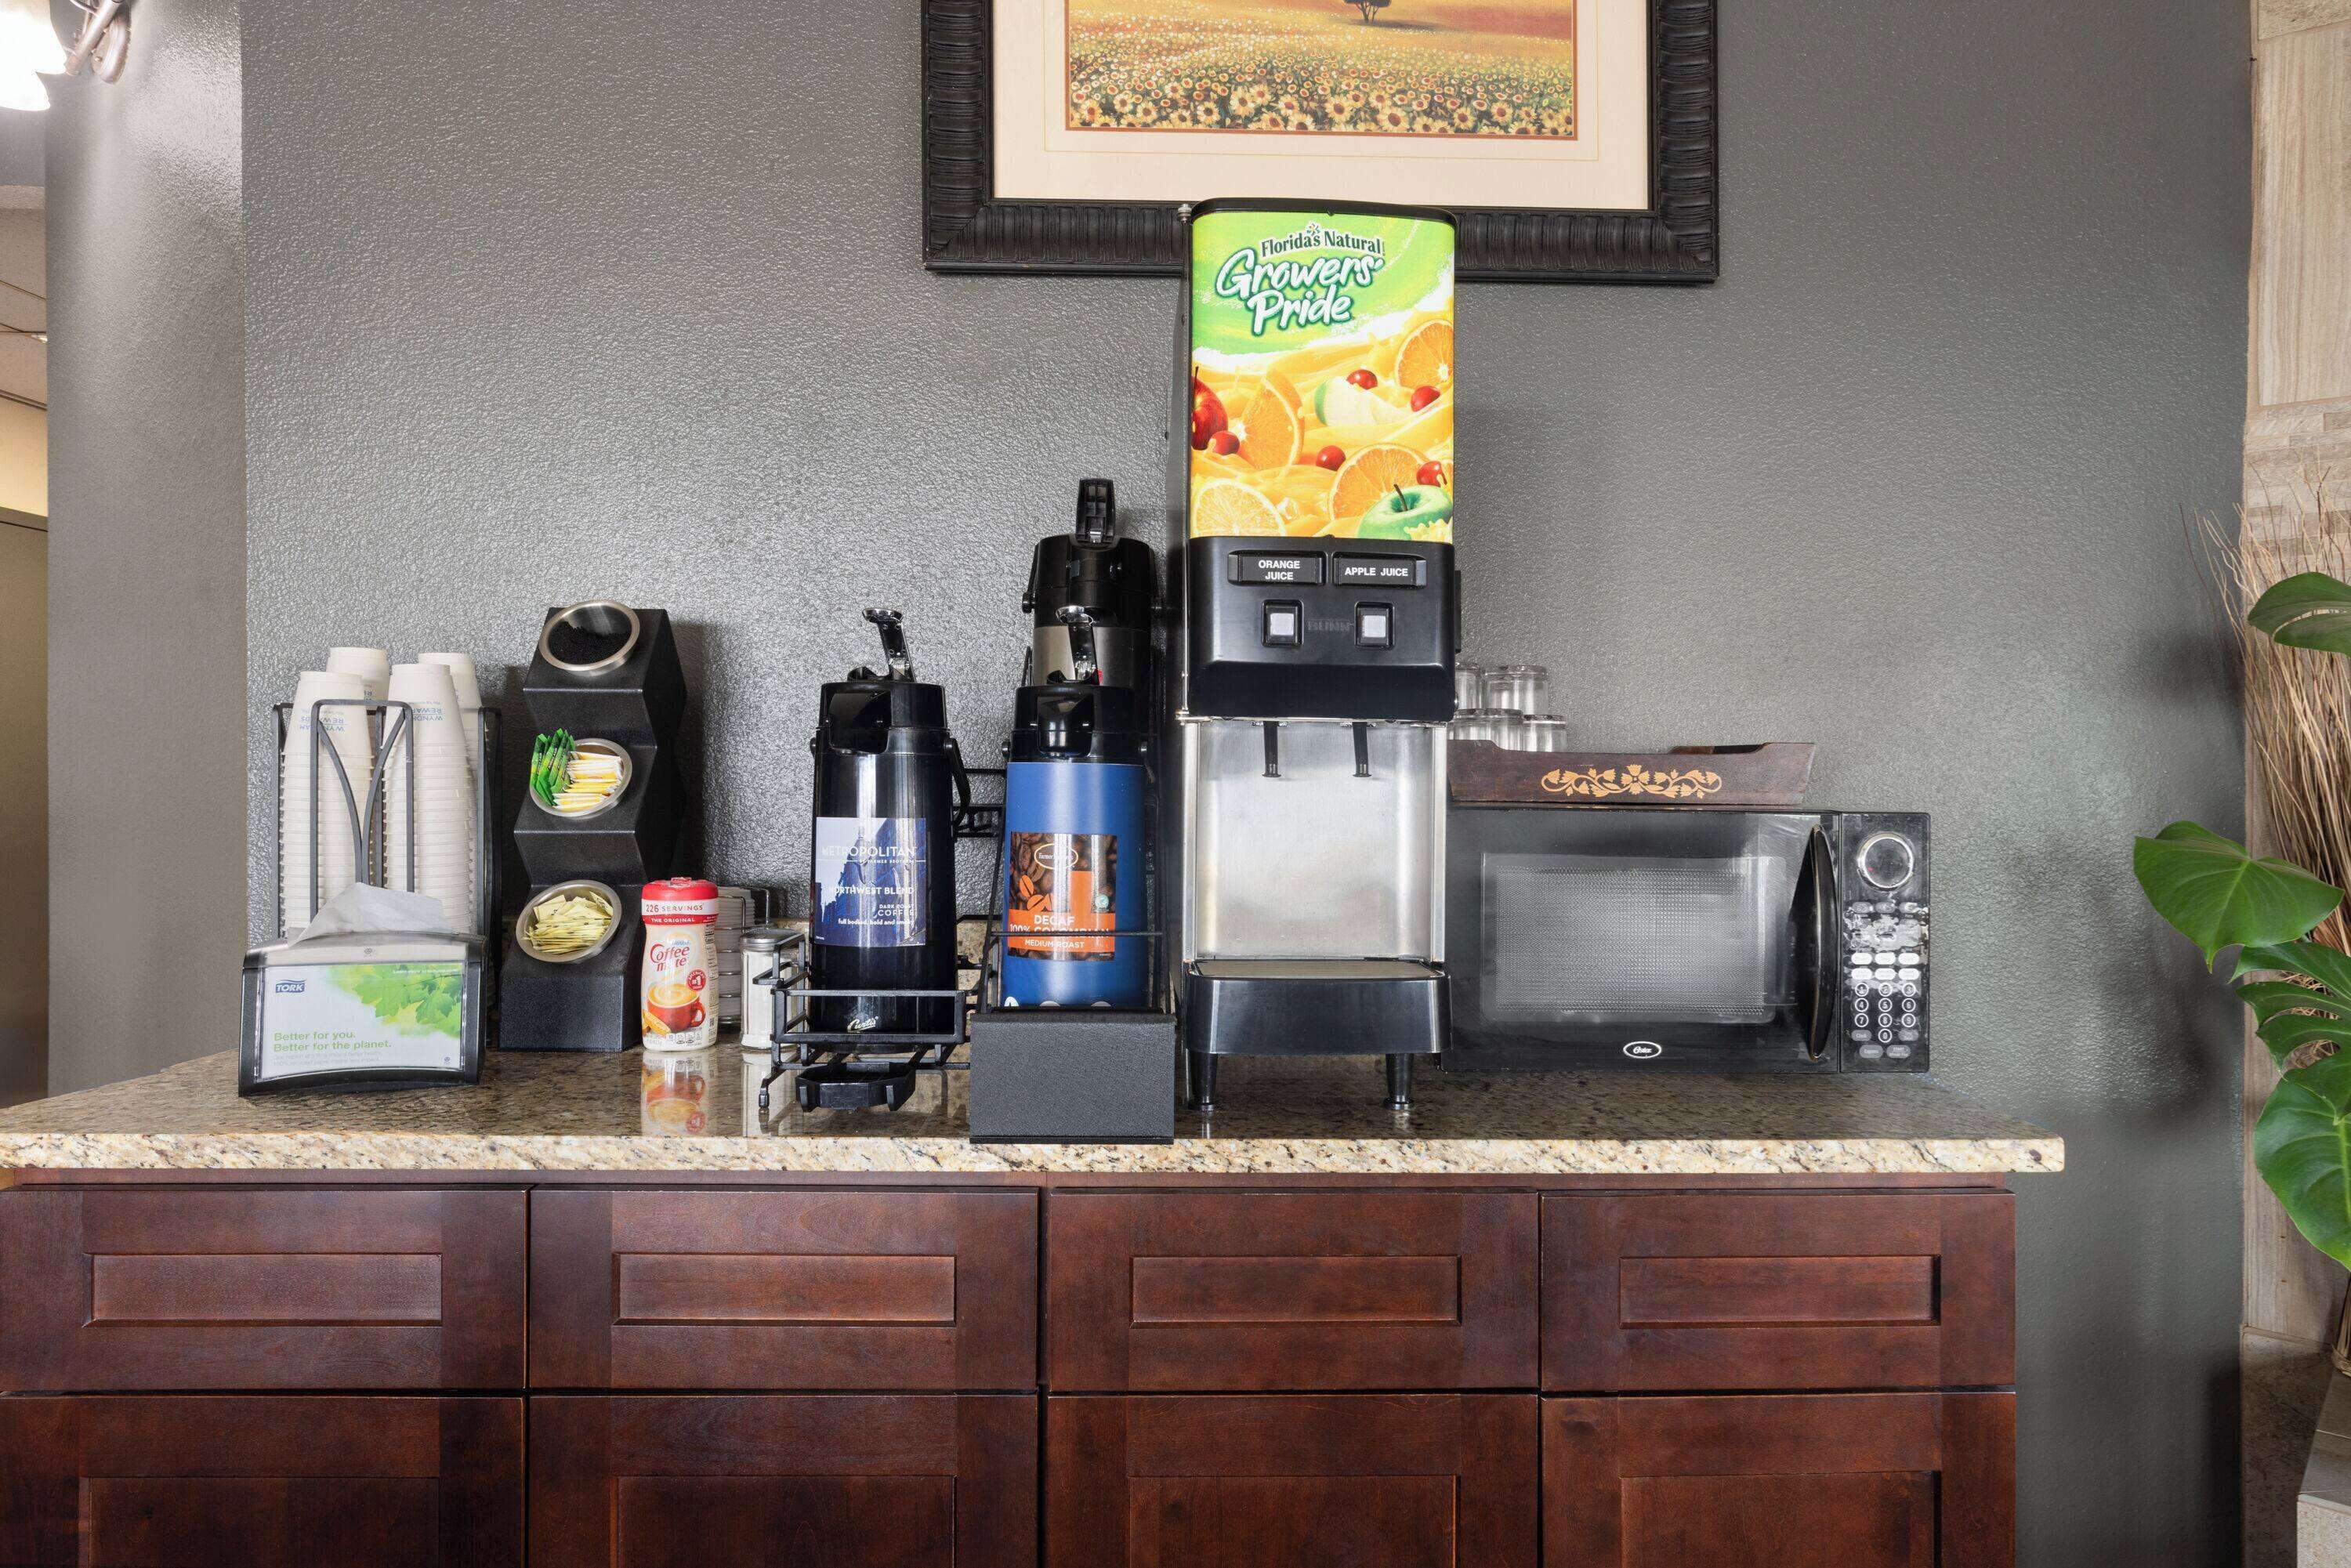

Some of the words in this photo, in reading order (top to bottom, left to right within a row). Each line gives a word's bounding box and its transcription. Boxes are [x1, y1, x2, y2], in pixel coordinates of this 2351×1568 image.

[1324, 230, 1381, 254] Natural
[1246, 284, 1353, 335] Pride
[1259, 560, 1301, 569] ORANGE
[1265, 571, 1294, 581] JUICE
[1344, 567, 1376, 576] APPLE
[1381, 568, 1409, 577] JUICE
[1034, 915, 1075, 925] DECAF
[650, 943, 690, 963] Coffee
[273, 1033, 309, 1041] Better
[313, 1031, 330, 1040] for
[332, 1031, 356, 1041] you.
[273, 1044, 309, 1052] Better
[313, 1042, 330, 1051] for
[332, 1041, 351, 1050] the
[353, 1040, 392, 1052] planet.
